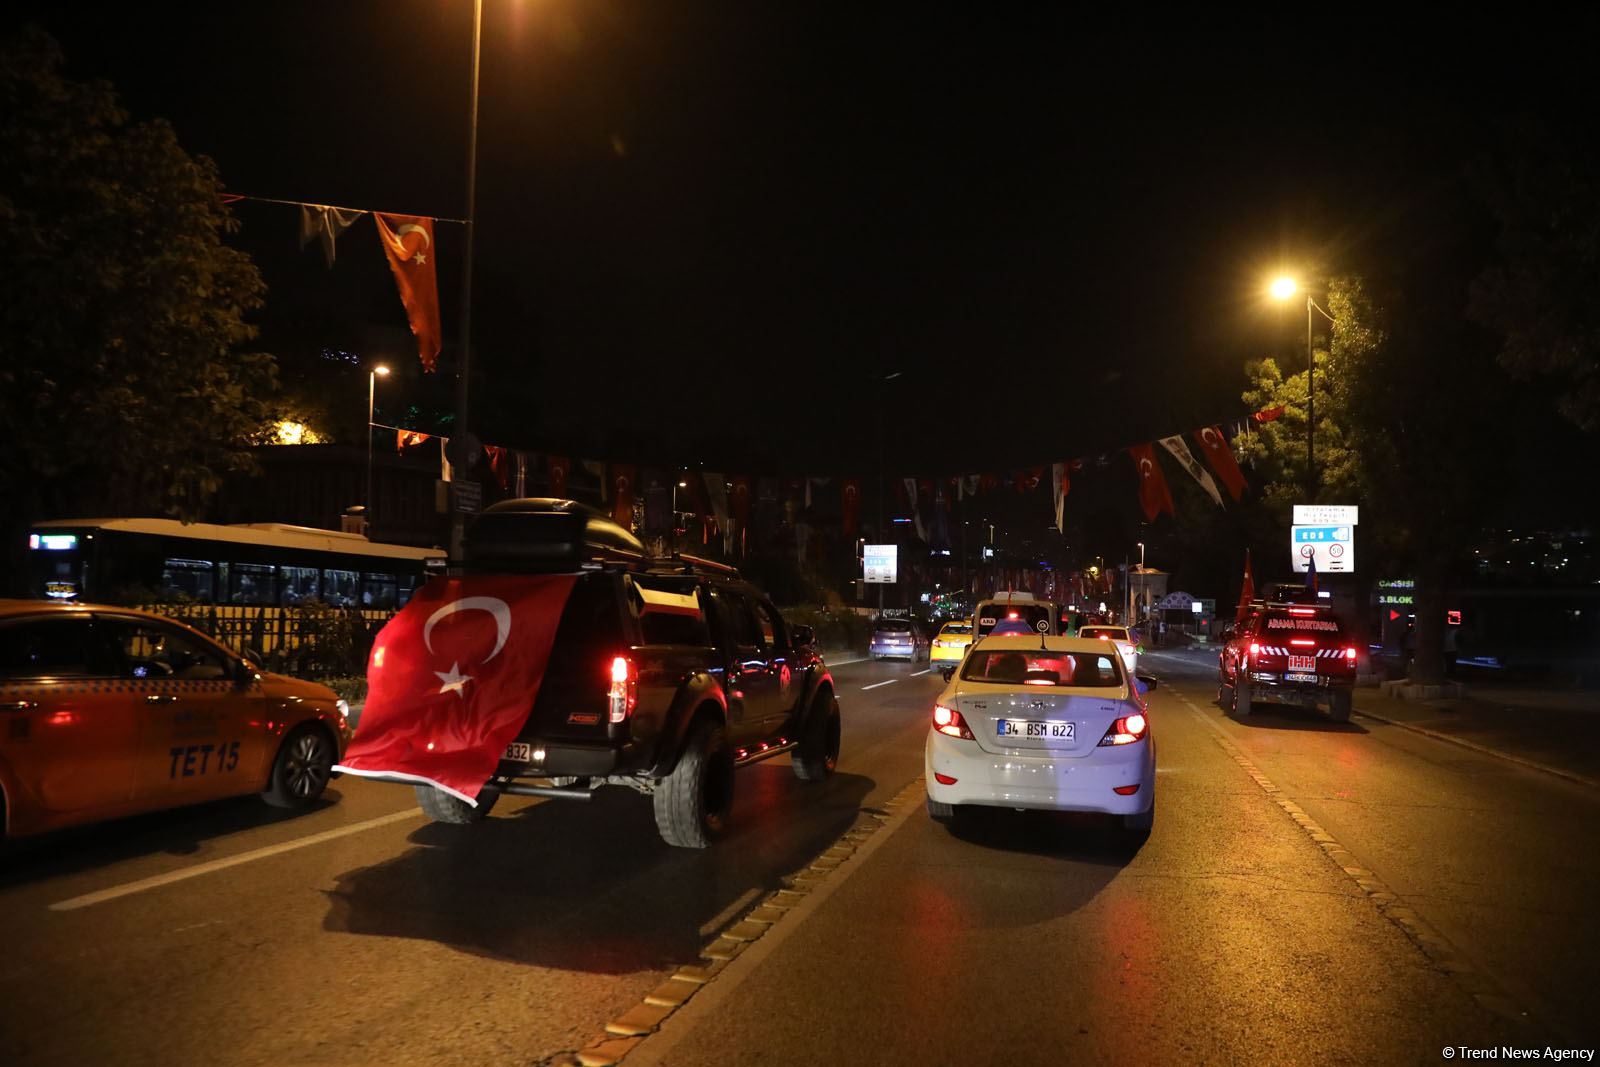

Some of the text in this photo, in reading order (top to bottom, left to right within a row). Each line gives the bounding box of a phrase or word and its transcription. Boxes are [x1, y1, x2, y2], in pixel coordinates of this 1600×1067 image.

[1006, 722, 1073, 738] 34 BSM 822
[170, 740, 240, 779] TET 15
[506, 744, 527, 760] 832
